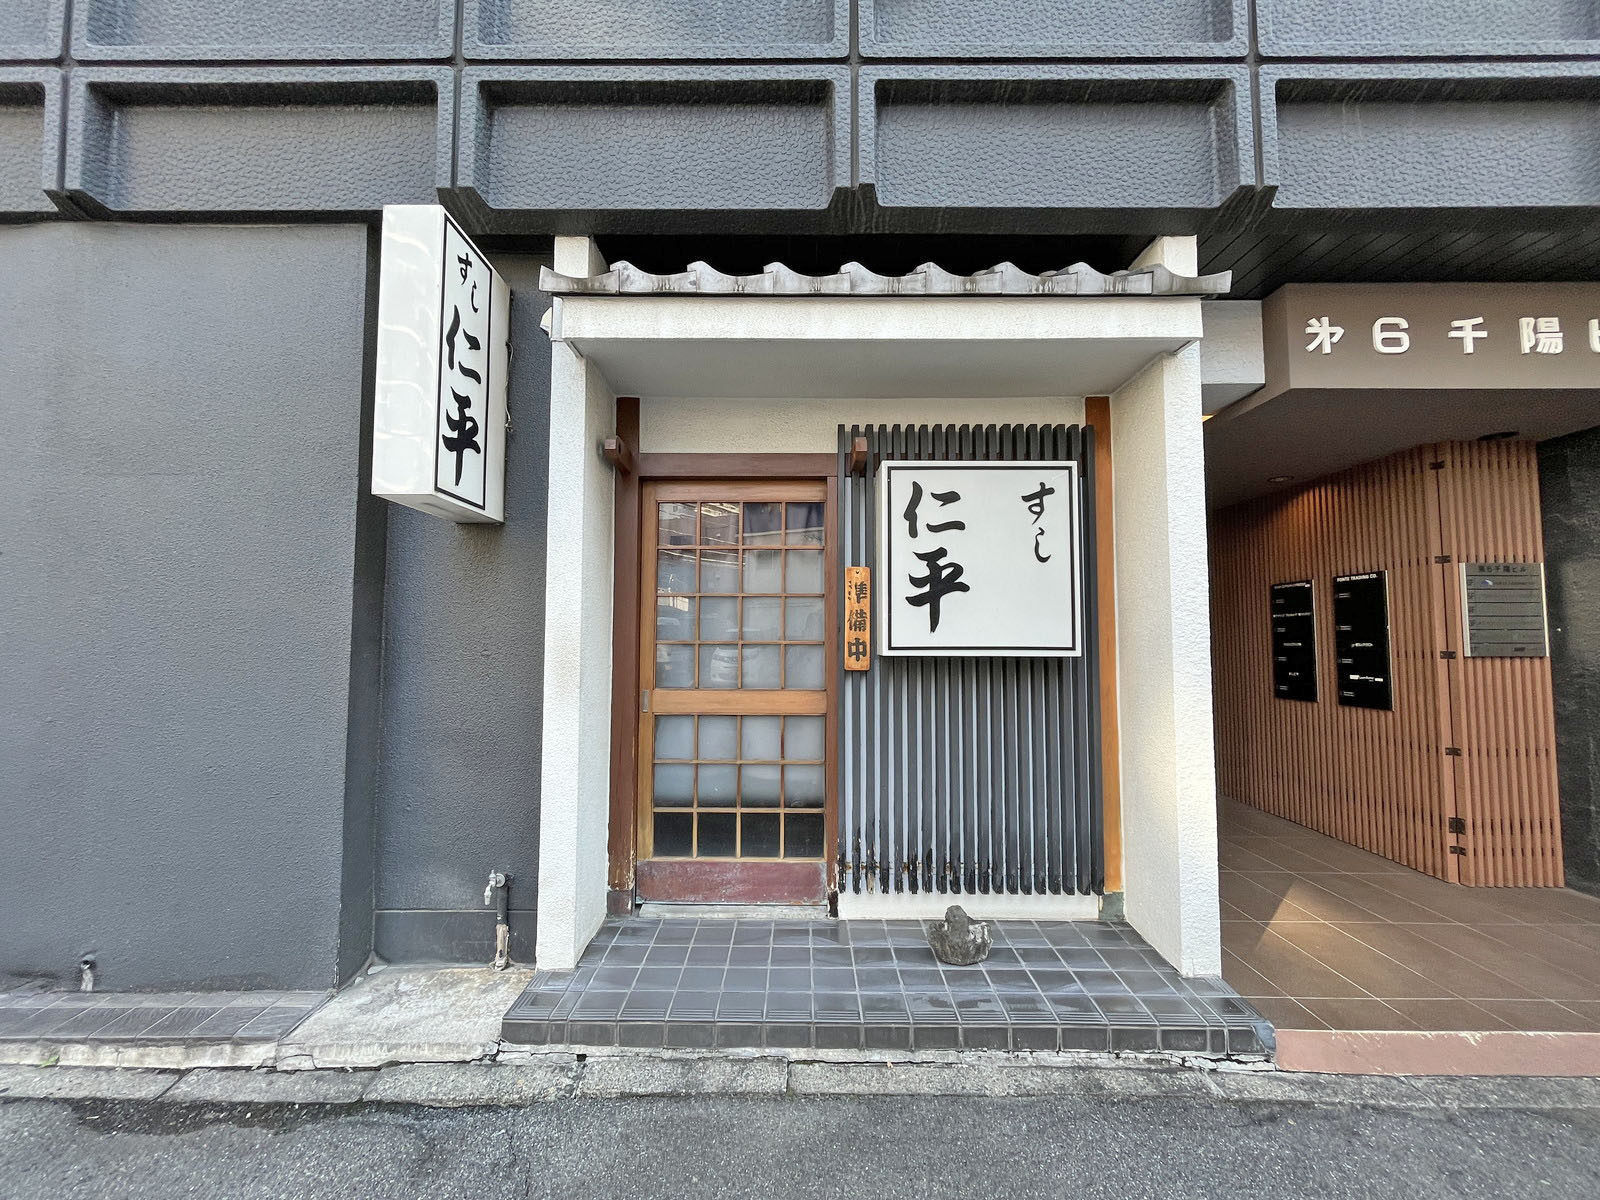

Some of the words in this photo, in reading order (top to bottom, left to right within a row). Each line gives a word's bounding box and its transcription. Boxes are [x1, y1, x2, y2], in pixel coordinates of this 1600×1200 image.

[903, 480, 971, 634] 仁平
[1020, 481, 1056, 563] すし
[846, 579, 868, 662] 準備中
